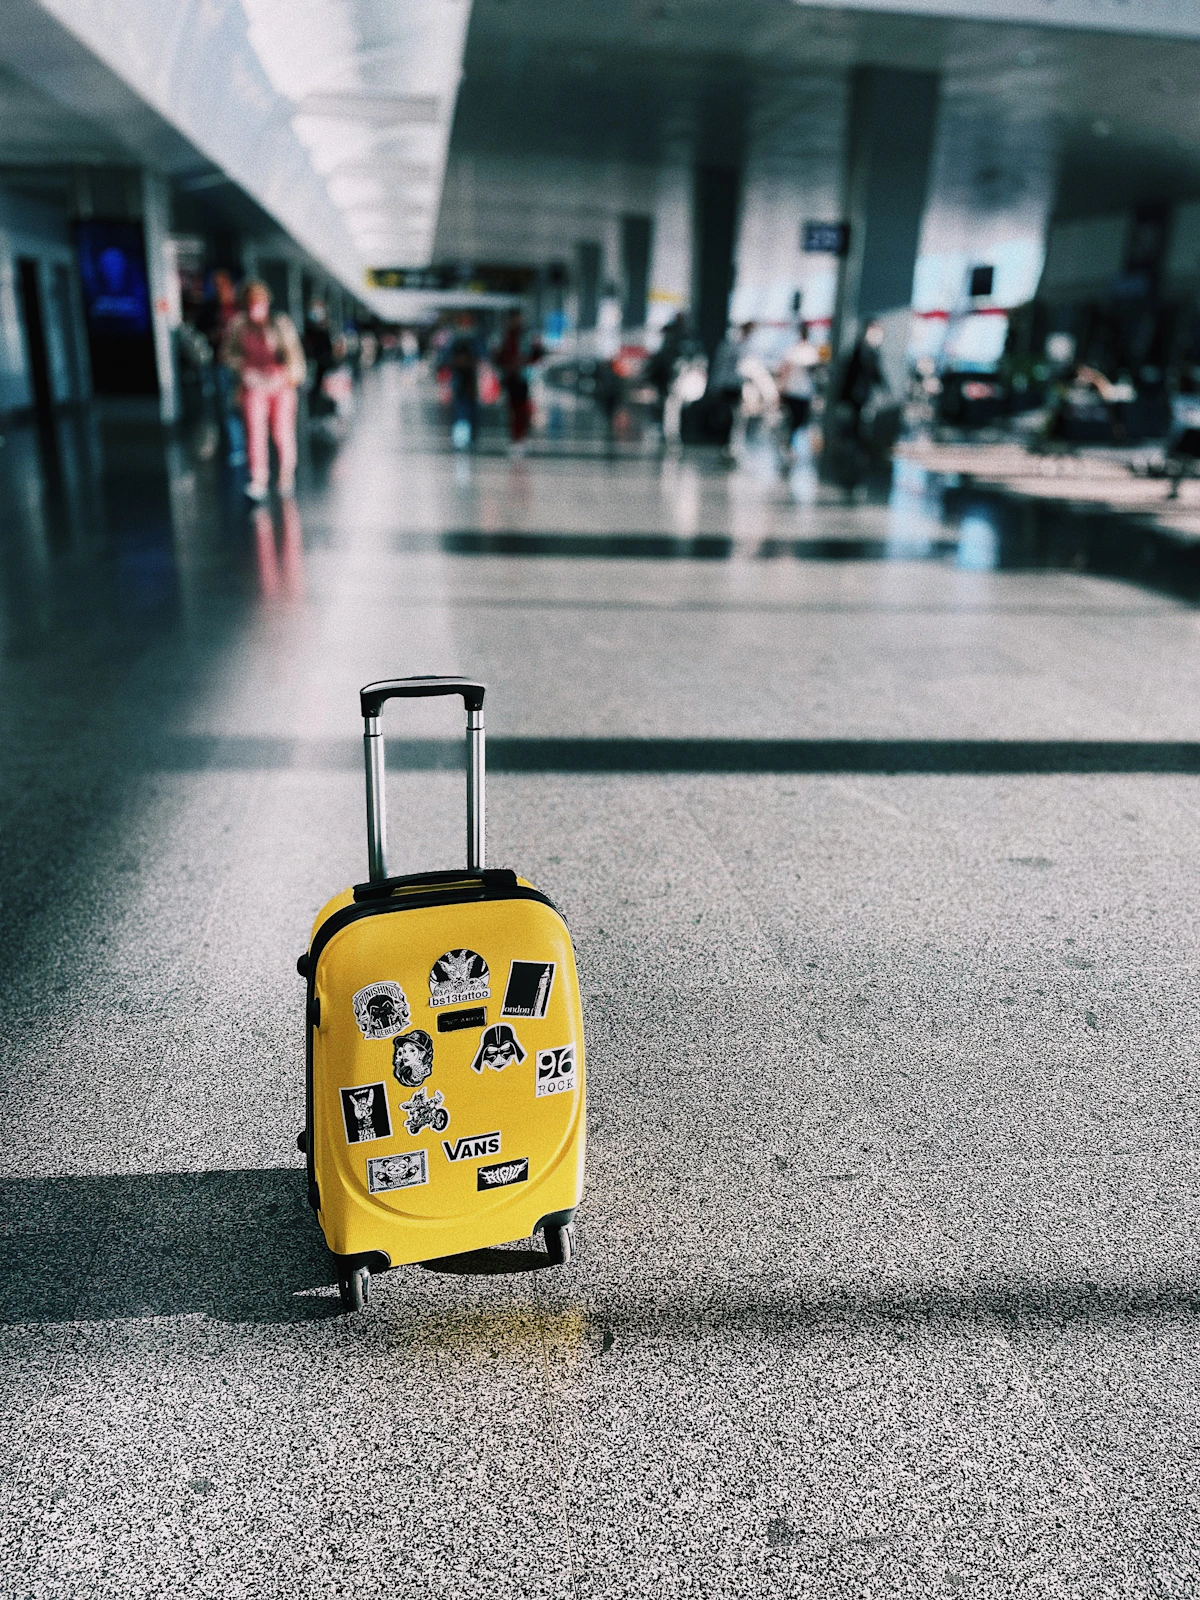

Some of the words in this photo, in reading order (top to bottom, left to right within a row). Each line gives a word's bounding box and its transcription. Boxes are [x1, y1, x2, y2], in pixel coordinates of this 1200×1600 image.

[358, 985, 398, 1009] PUNISHING
[432, 990, 489, 1006] bs13tattoo
[504, 1004, 530, 1014] ondon
[375, 1023, 400, 1036] REBELS
[539, 1046, 574, 1080] 96
[538, 1078, 574, 1096] ROCK
